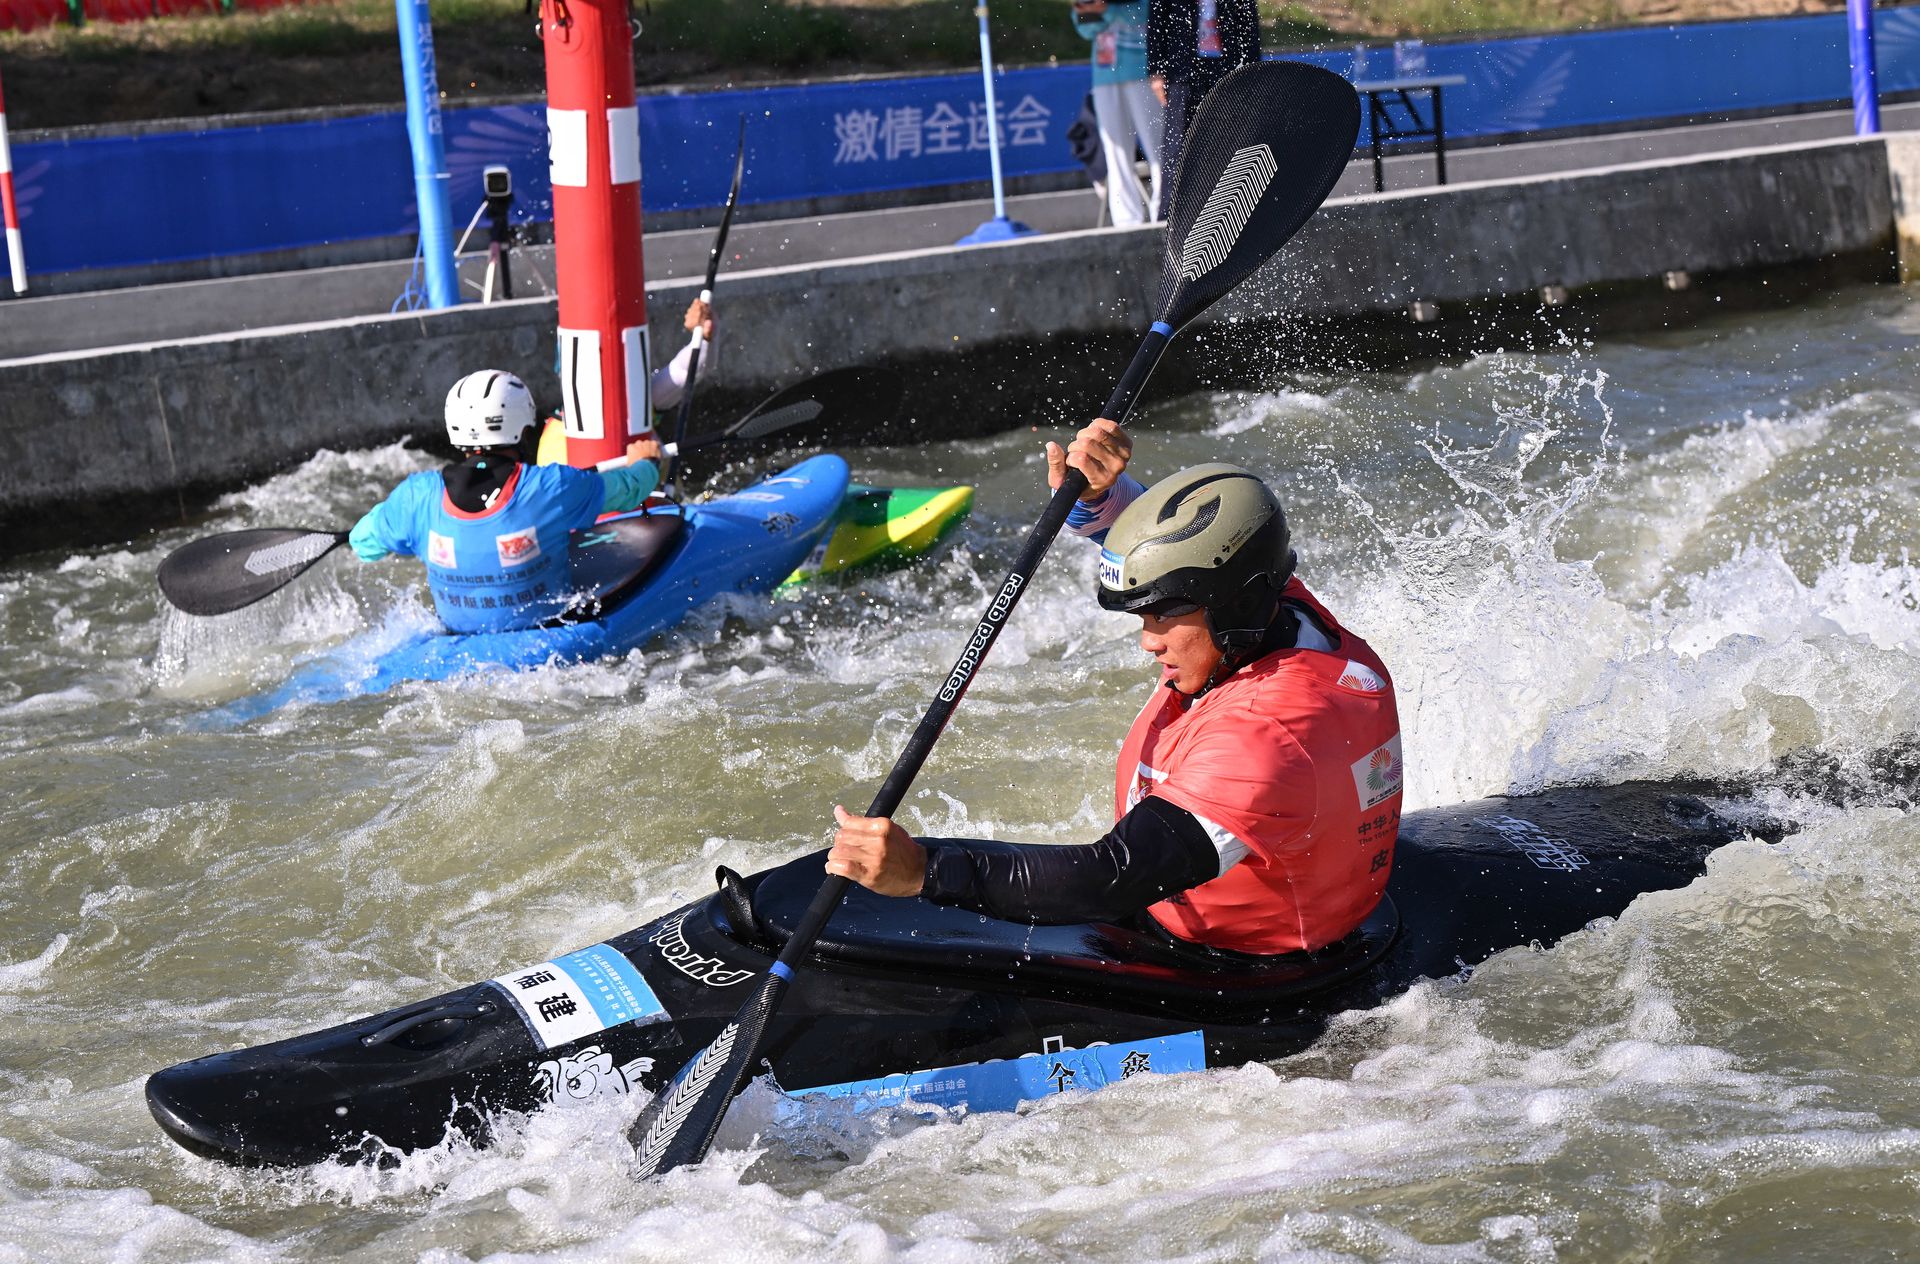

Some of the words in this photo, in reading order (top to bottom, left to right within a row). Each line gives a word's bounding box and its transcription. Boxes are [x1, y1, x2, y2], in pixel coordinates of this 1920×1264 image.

[833, 94, 1051, 164] 激情全运会
[1229, 529, 1242, 543] Sweet
[988, 573, 1024, 622] raab
[1099, 561, 1119, 585] CHN
[940, 622, 995, 702] paddles
[513, 970, 577, 1022] 福建
